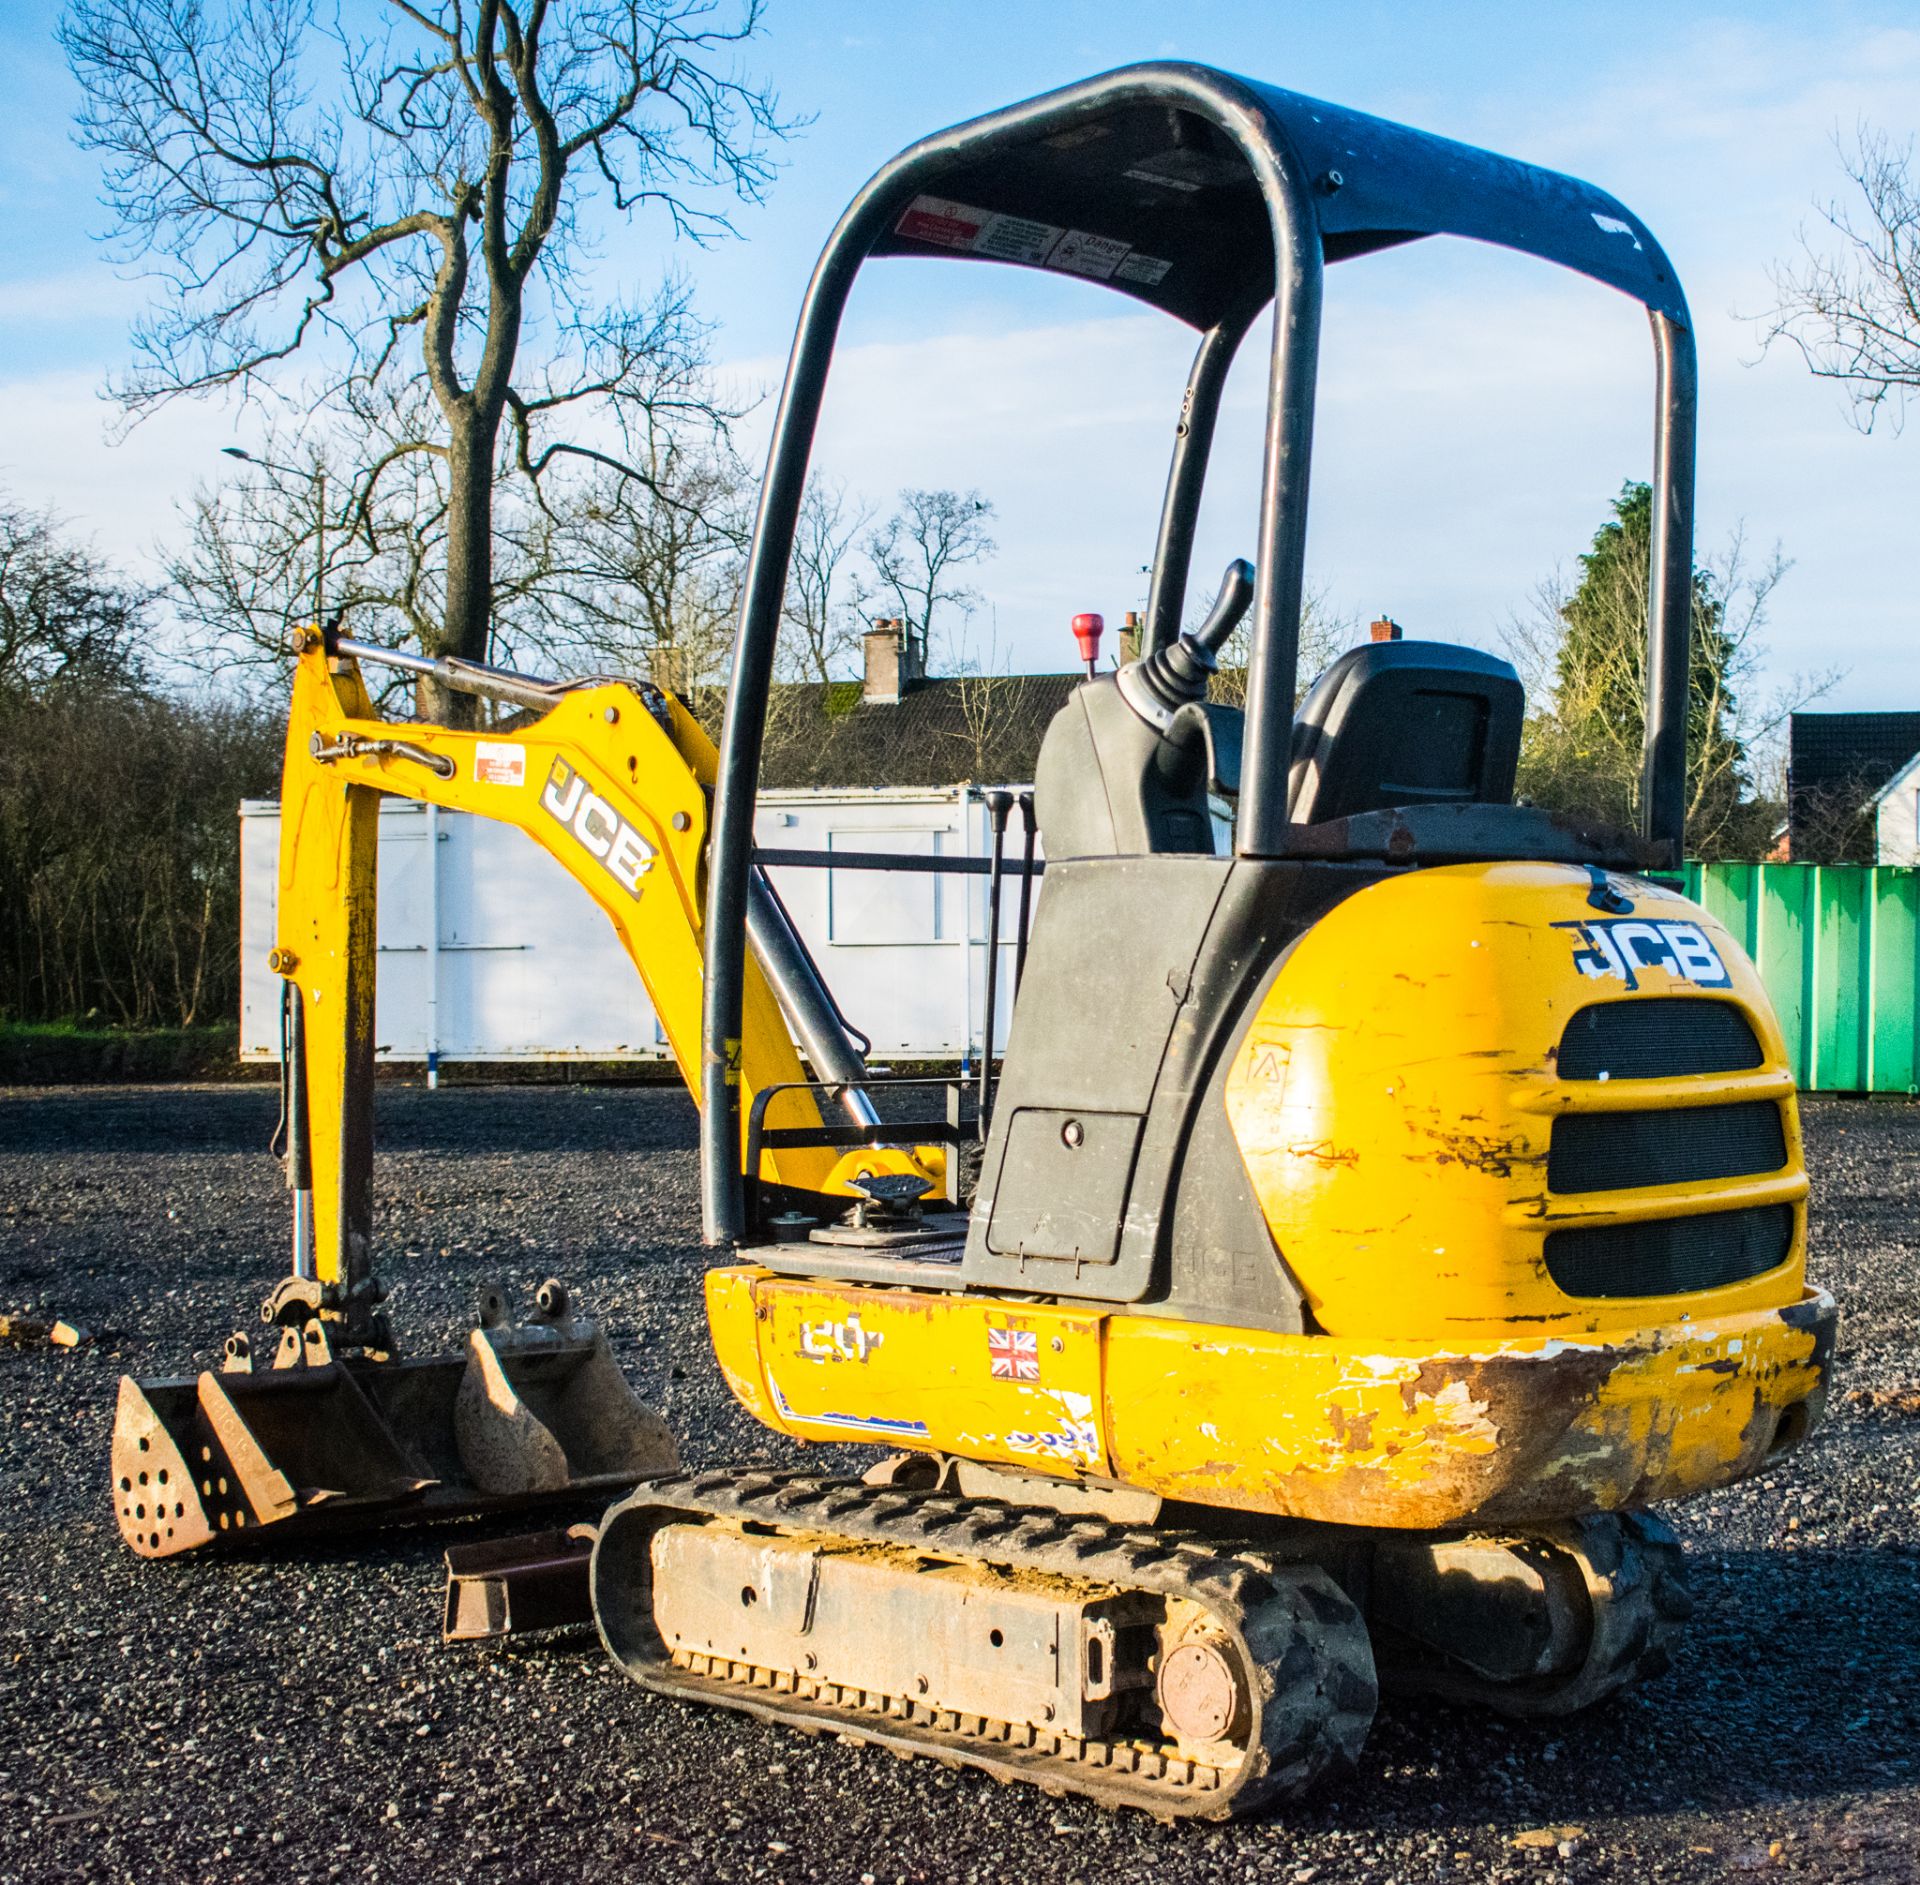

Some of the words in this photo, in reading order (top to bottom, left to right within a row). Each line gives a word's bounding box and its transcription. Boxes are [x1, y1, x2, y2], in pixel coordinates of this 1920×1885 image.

[1085, 236, 1129, 254] Danger
[544, 774, 654, 892] JCB
[1577, 922, 1725, 981] JCB
[1176, 1245, 1263, 1289] JCB
